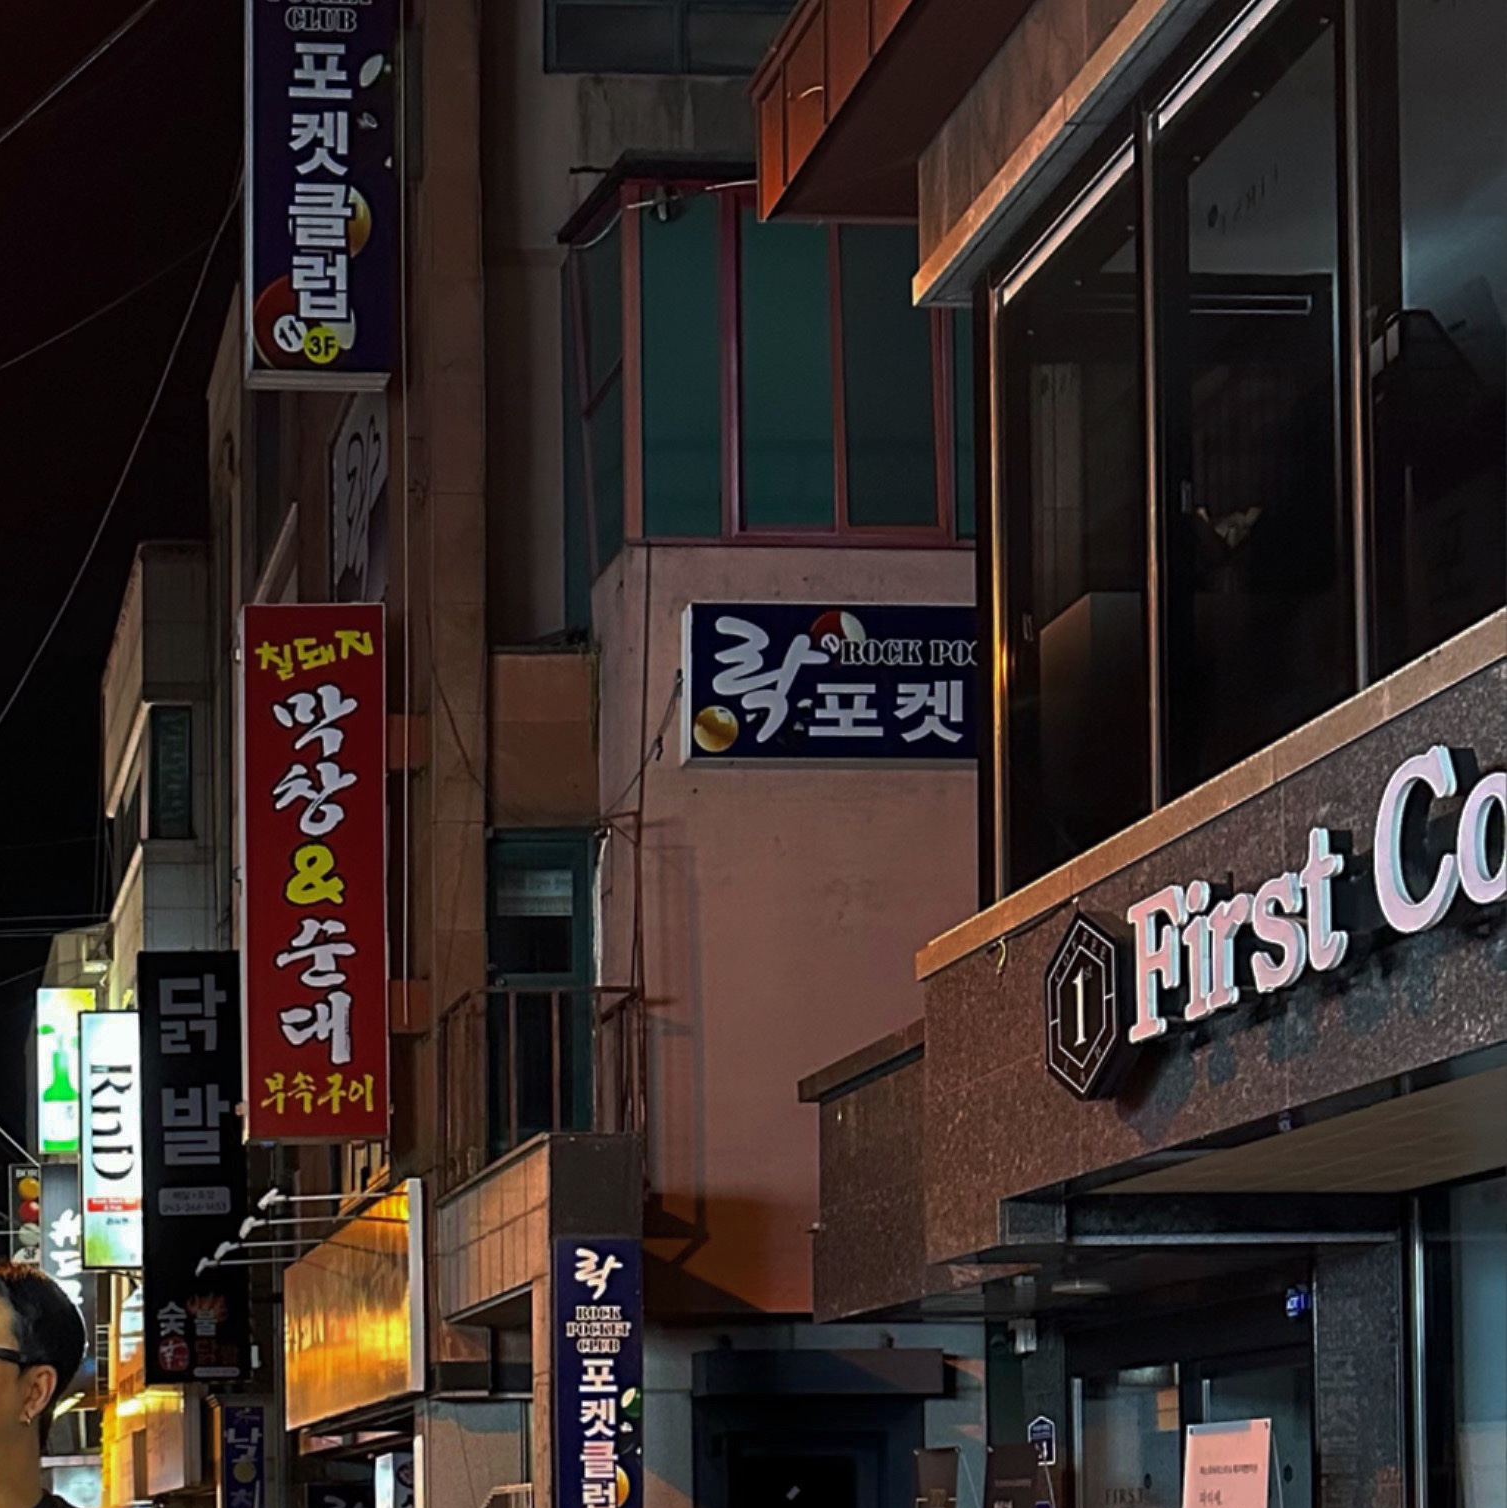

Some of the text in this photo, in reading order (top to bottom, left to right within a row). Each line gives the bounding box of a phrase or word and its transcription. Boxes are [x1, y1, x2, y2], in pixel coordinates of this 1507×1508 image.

[285, 8, 357, 33] CLUB
[288, 42, 355, 322] 포켓클럽
[307, 334, 338, 357] 3F
[255, 629, 374, 681] 칠돼지
[842, 638, 922, 665] ROCK
[809, 680, 963, 743] 포켓
[1127, 827, 1349, 1044] First
[158, 973, 230, 1166] 닭발
[575, 1305, 622, 1320] ROCK
[566, 1321, 632, 1337] POCKET
[576, 1338, 621, 1353] CLUB
